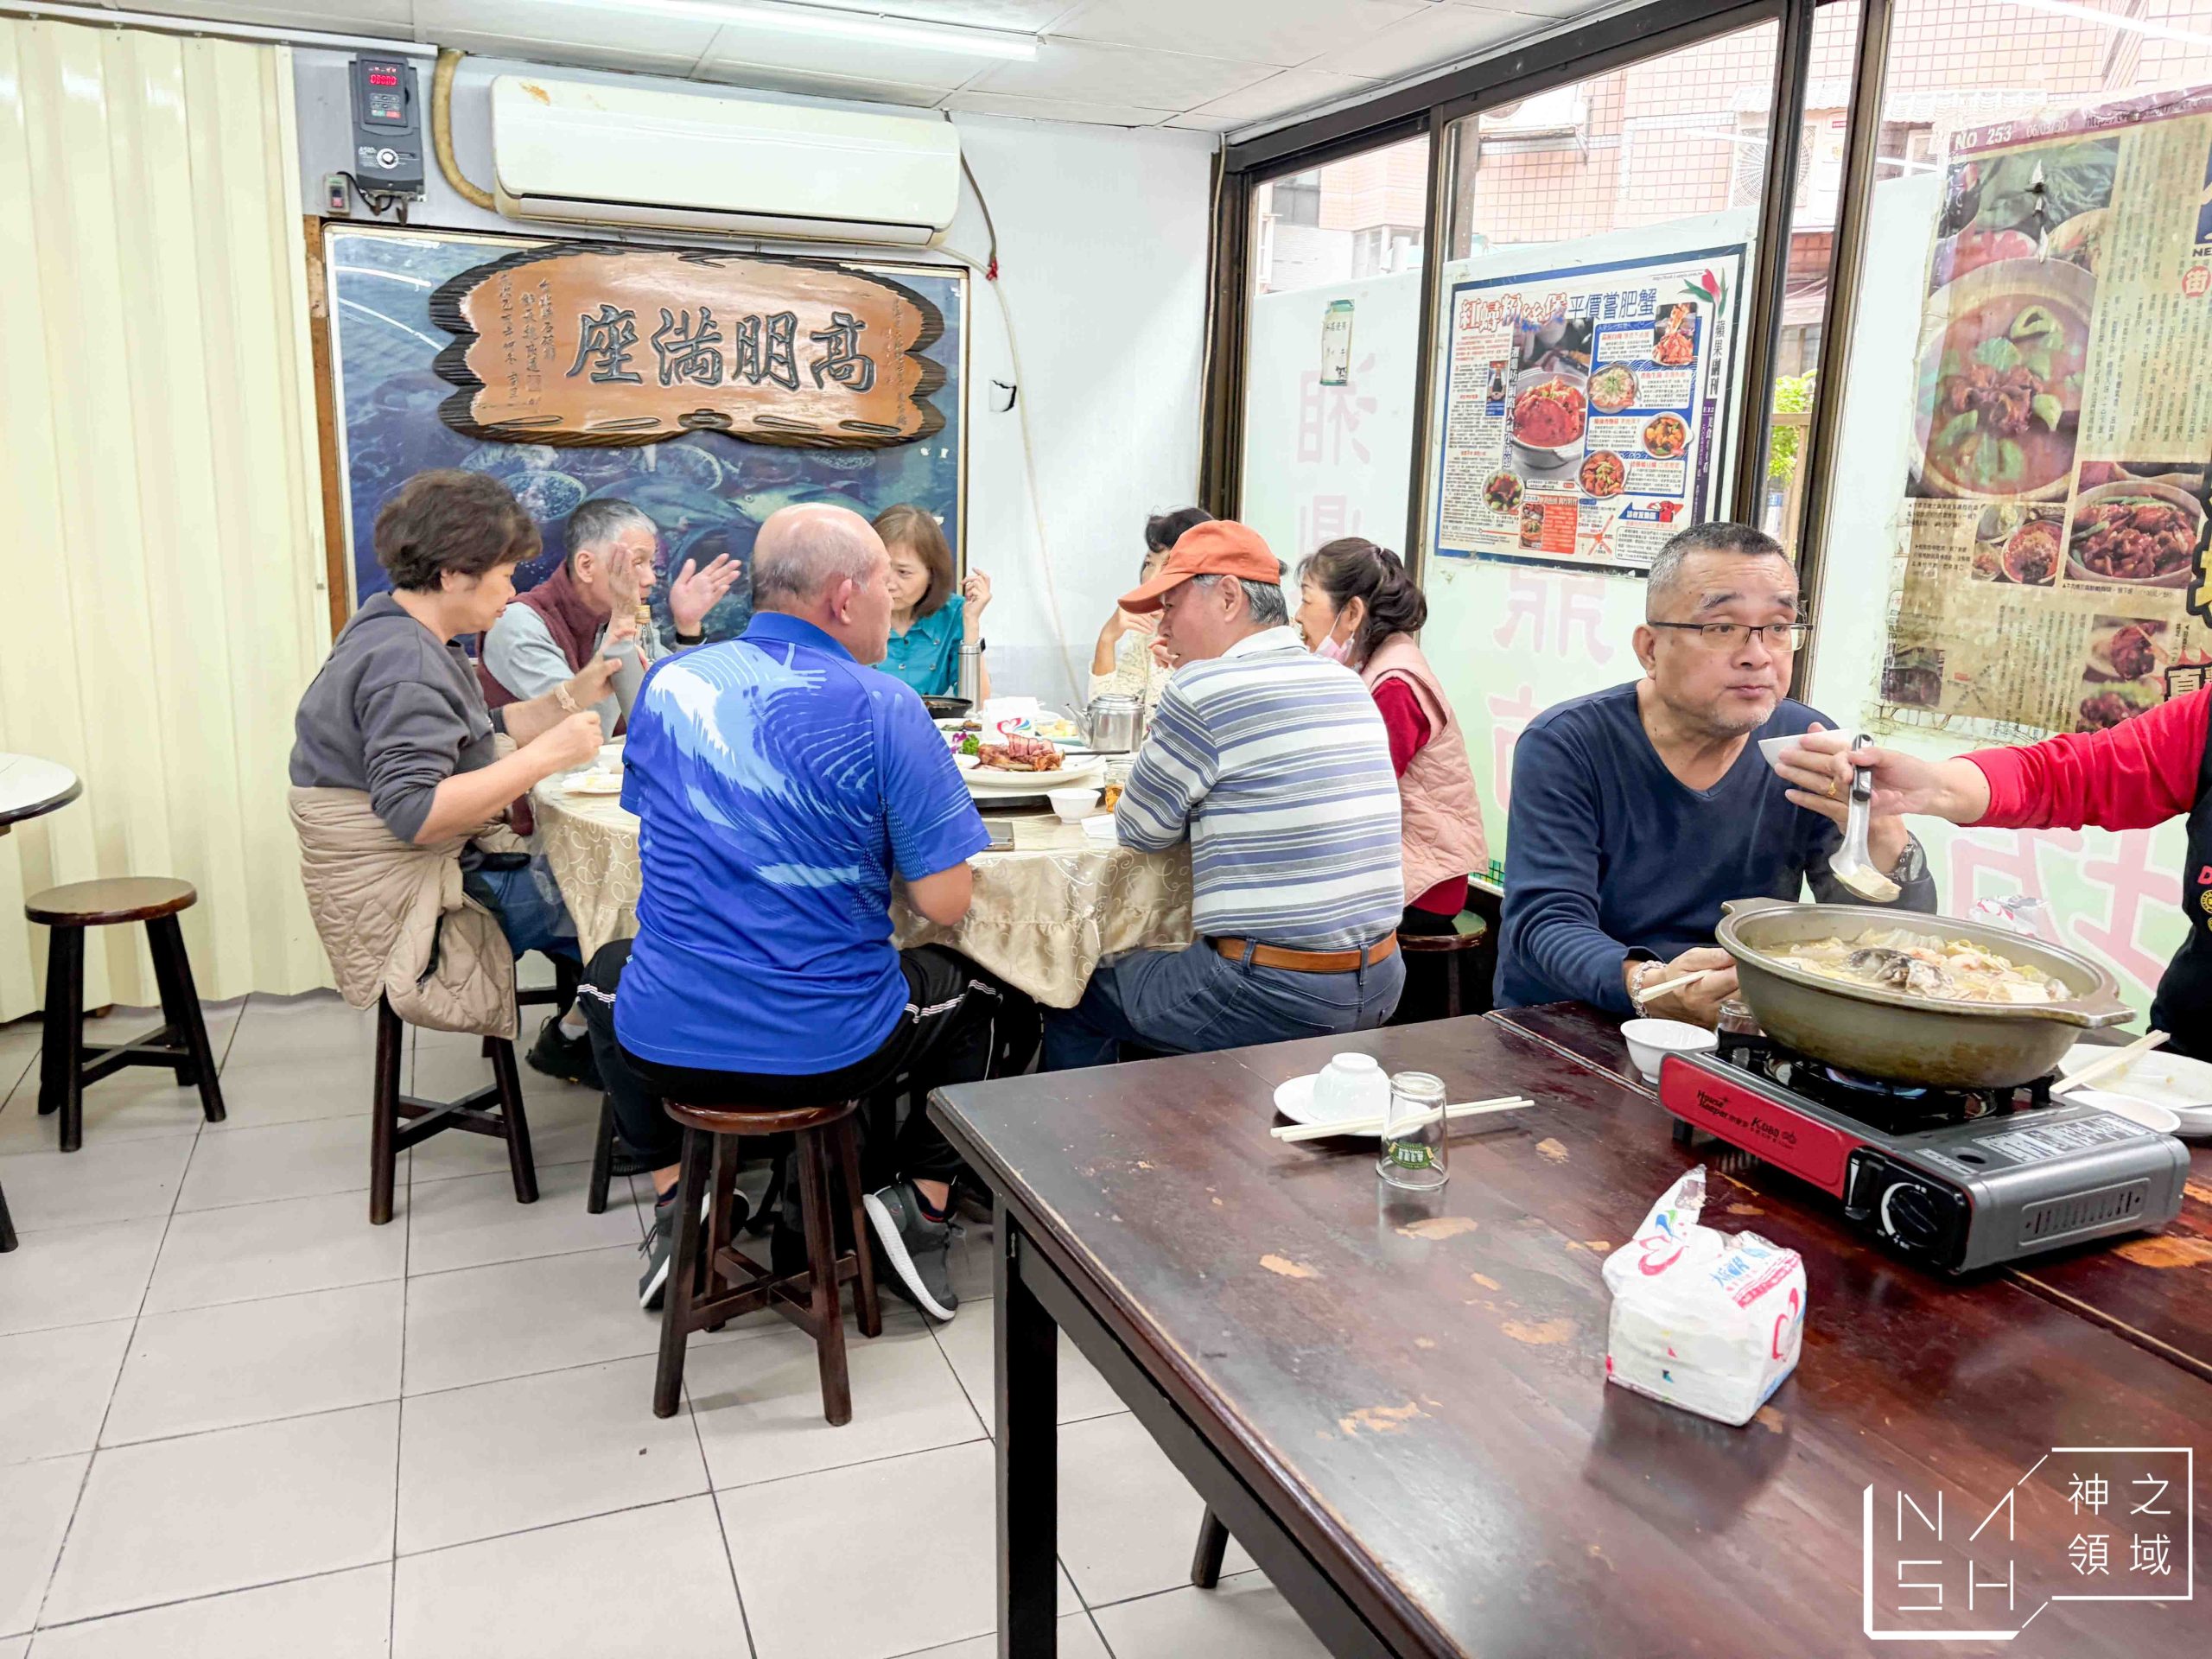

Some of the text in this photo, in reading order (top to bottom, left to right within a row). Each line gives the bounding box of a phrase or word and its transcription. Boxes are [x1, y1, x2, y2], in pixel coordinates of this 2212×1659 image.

[1954, 130, 1978, 149] NO
[1986, 125, 2012, 145] 253
[1709, 320, 1726, 397] 蘋果副刊
[1697, 1090, 1726, 1109] House
